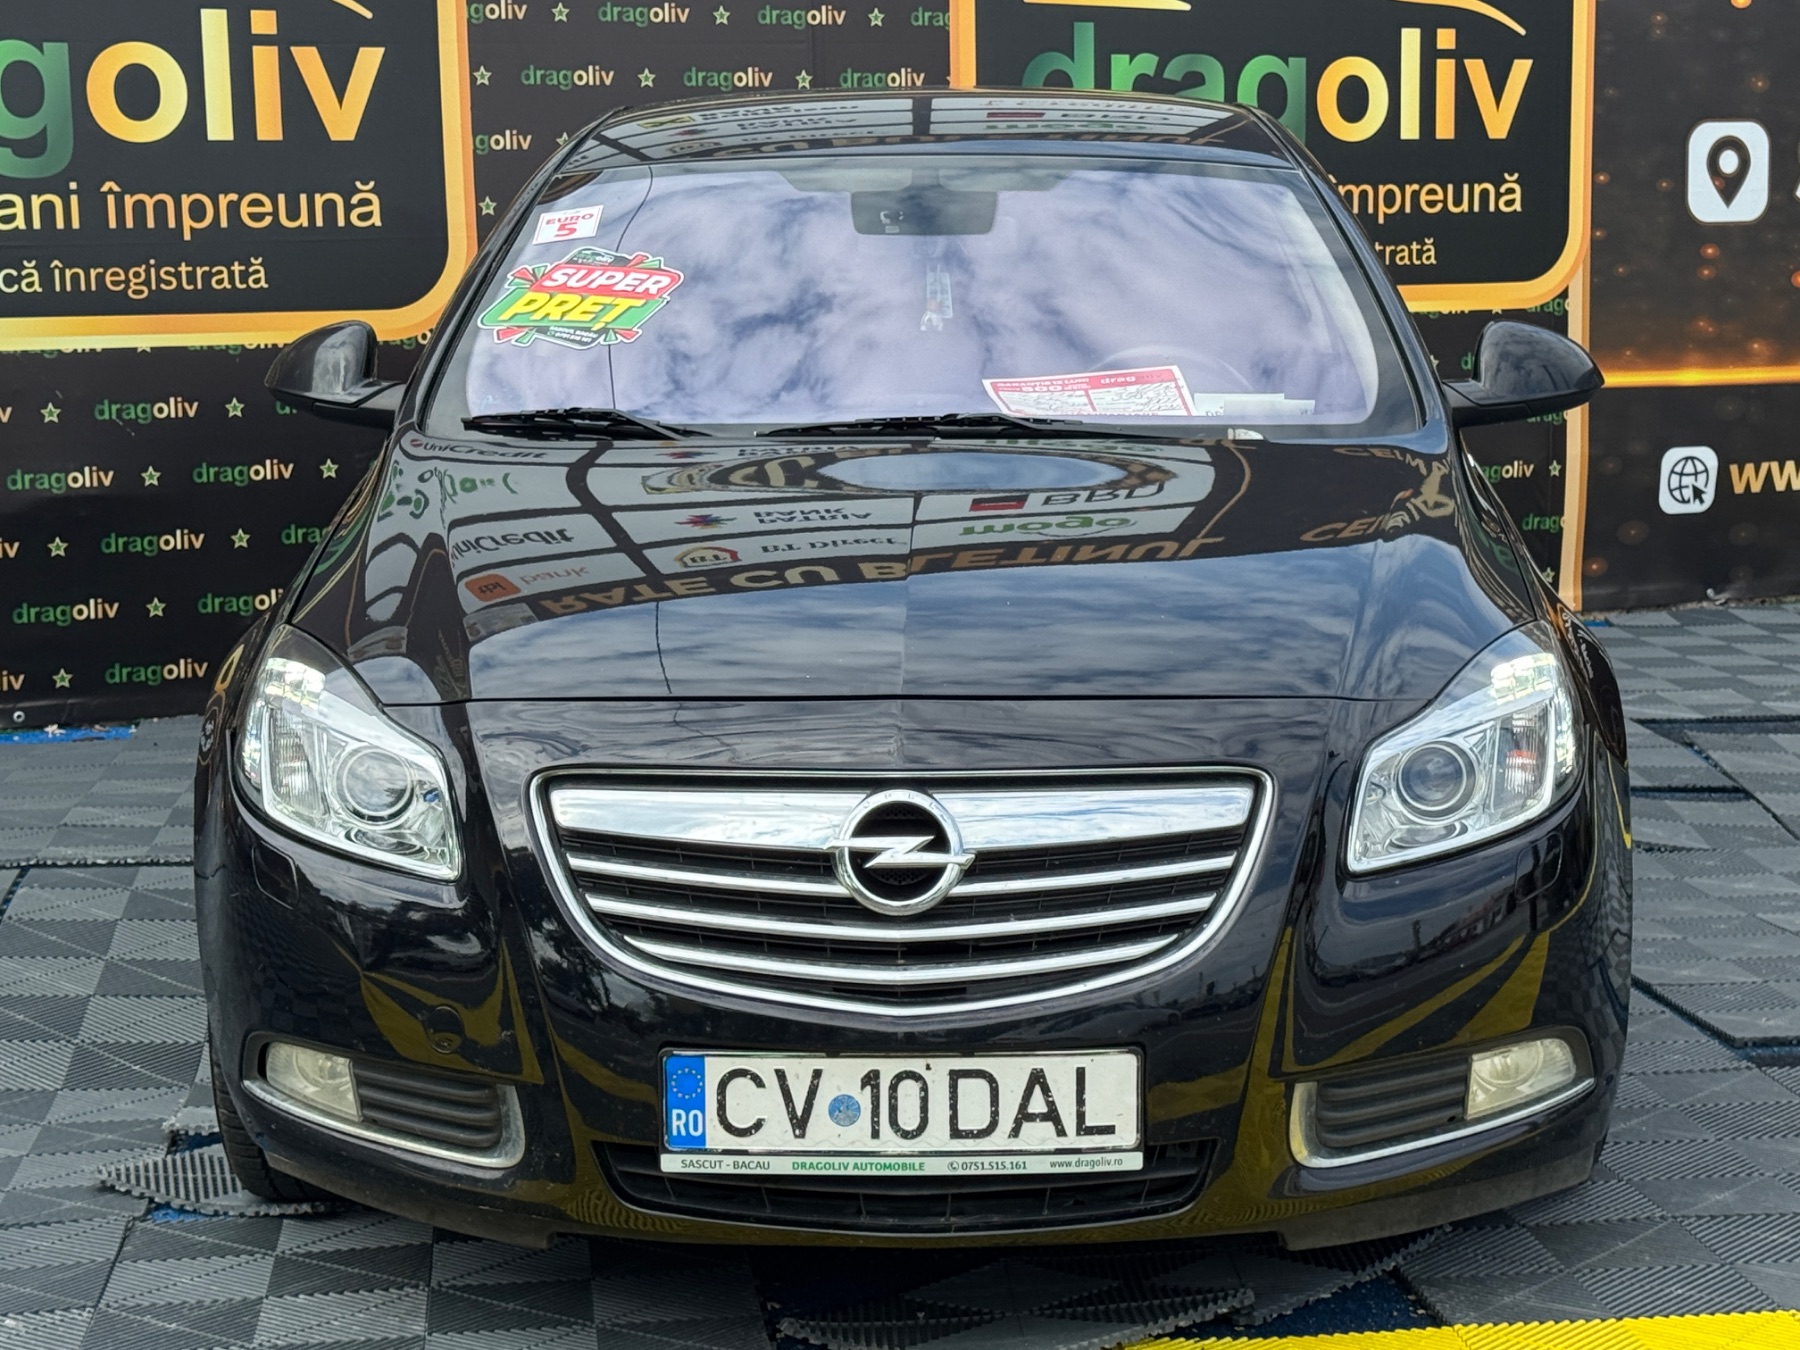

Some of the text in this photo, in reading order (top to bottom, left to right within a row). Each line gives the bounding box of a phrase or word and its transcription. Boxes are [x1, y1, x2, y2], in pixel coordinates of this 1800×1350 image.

[598, 1, 690, 28] dragoliv
[757, 4, 847, 30] dragoliv
[520, 64, 615, 91] dragoliv
[683, 66, 773, 92] dragoliv
[839, 67, 925, 89] dragoliv
[99, 180, 383, 241] împreună
[1327, 172, 1523, 225] mpreună
[545, 213, 594, 226] EURO
[553, 221, 578, 238] 5
[49, 256, 269, 300] înregistrată
[541, 267, 671, 296] SUPER
[497, 291, 648, 331] PREȚ
[94, 396, 199, 424] dragoliv
[6, 465, 115, 494] dragoliv
[192, 458, 295, 487] dragoliv
[101, 528, 205, 557] dragoliv
[12, 598, 119, 627] dragoliv
[198, 588, 284, 618] dragol
[105, 657, 209, 686] dragoliv
[715, 1065, 1118, 1140] CV 10 DAL
[671, 1108, 703, 1137] RO
[680, 1158, 726, 1170] SASCUT
[732, 1160, 771, 1171] BACAU
[791, 1160, 850, 1172] DRAGOLIV
[852, 1161, 926, 1172] AUTOMOBILE
[961, 1160, 1028, 1172] 0751.515.161
[1049, 1157, 1124, 1170] www.dragoliv.ro
